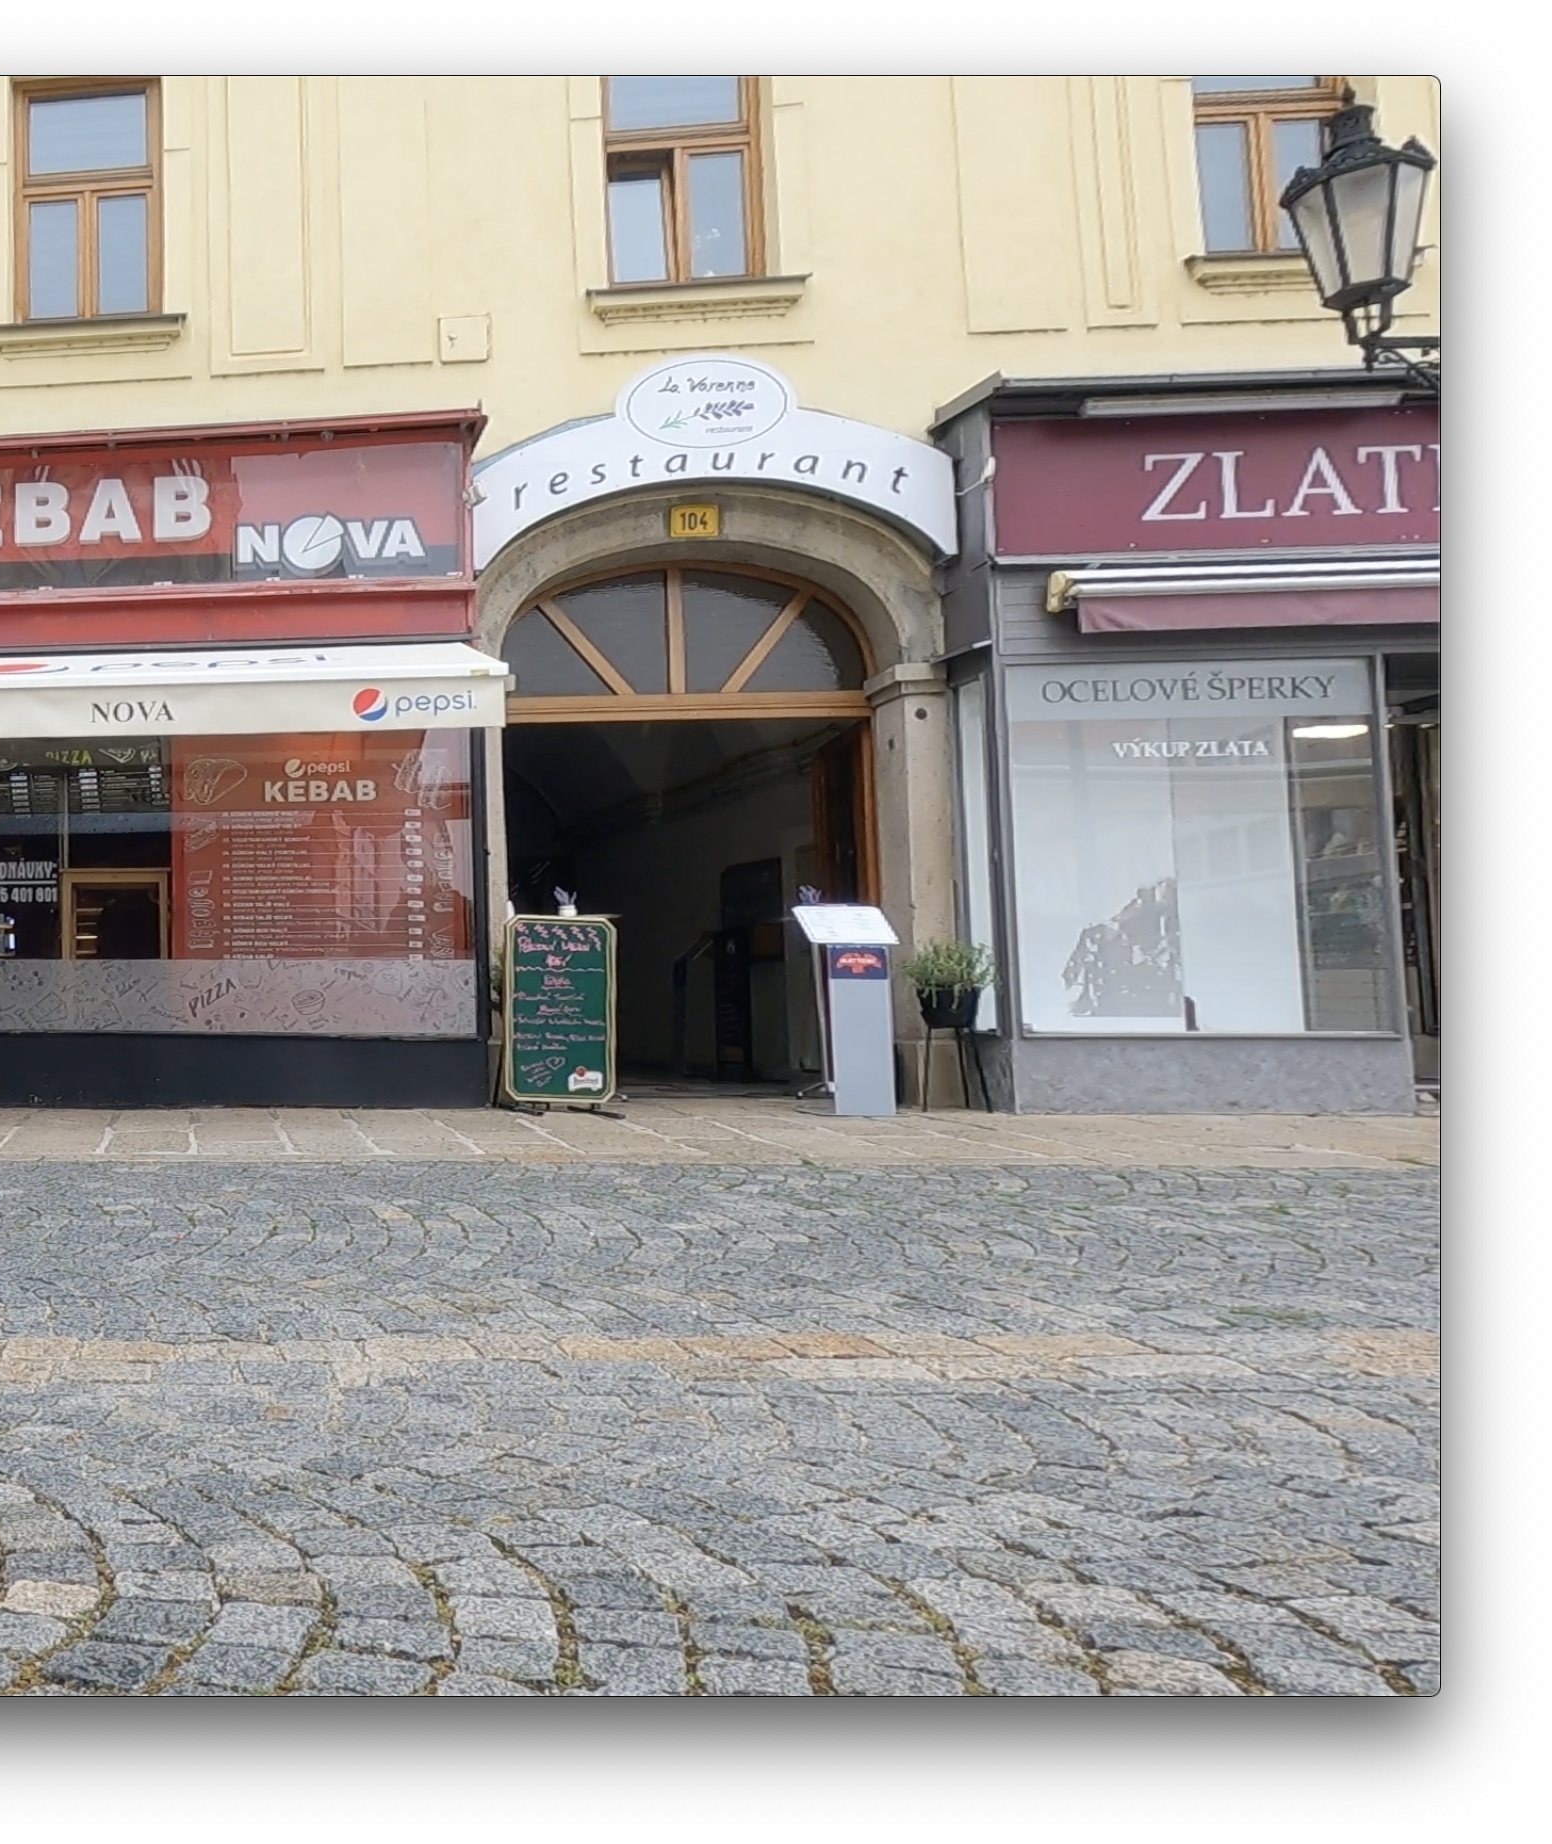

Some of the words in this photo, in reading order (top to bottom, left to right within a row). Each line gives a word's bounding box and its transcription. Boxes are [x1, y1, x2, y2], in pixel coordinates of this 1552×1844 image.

[511, 451, 910, 511] restaurant
[1141, 443, 1440, 521] ZLAT
[679, 511, 709, 531] 104
[234, 513, 427, 578] NOVA
[1041, 671, 1199, 703] OCELOVÉ
[1206, 670, 1335, 701] ŠPERKY
[89, 701, 175, 724] NOVA
[394, 689, 475, 717] pepsi
[1112, 737, 1191, 758] VÝKUP
[1195, 740, 1269, 758] ZLATA
[307, 760, 351, 776] pepsi
[264, 780, 377, 803] KEBAB
[10, 886, 34, 903] 401
[35, 886, 58, 903] 801
[187, 977, 238, 1017] PIZZA
